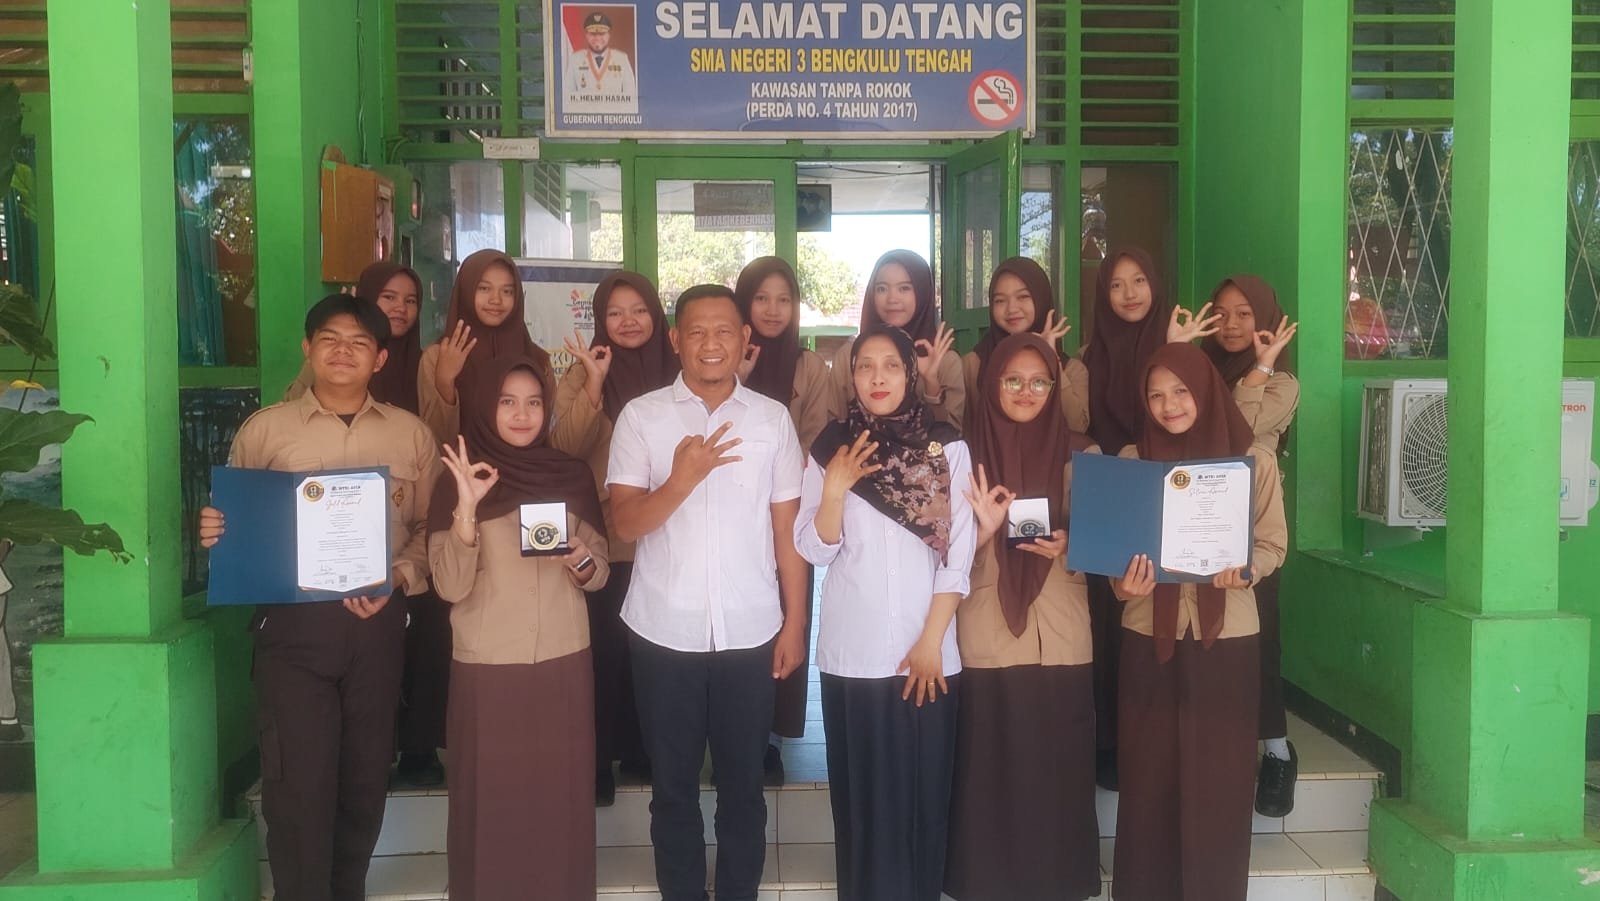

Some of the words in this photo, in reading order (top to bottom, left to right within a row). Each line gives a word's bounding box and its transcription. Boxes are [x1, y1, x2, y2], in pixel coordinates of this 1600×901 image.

[655, 2, 847, 39] SELAMAT
[861, 3, 1023, 40] DATANG
[690, 48, 726, 73] SMA
[731, 48, 791, 73] NEGERI
[796, 49, 806, 73] 3
[811, 49, 900, 73] BENGKULU
[905, 49, 972, 73] TENGAH
[751, 82, 817, 98] KAWASAN
[820, 82, 862, 98] TANPA
[866, 82, 912, 98] ROKOK
[563, 114, 602, 124] GUBERNUR
[603, 114, 642, 124] BENGKULU
[746, 101, 793, 120] (PERDA
[797, 101, 820, 118] NO.
[823, 102, 832, 118] 4
[835, 102, 879, 118] TAHUN
[883, 102, 918, 121] 2017)
